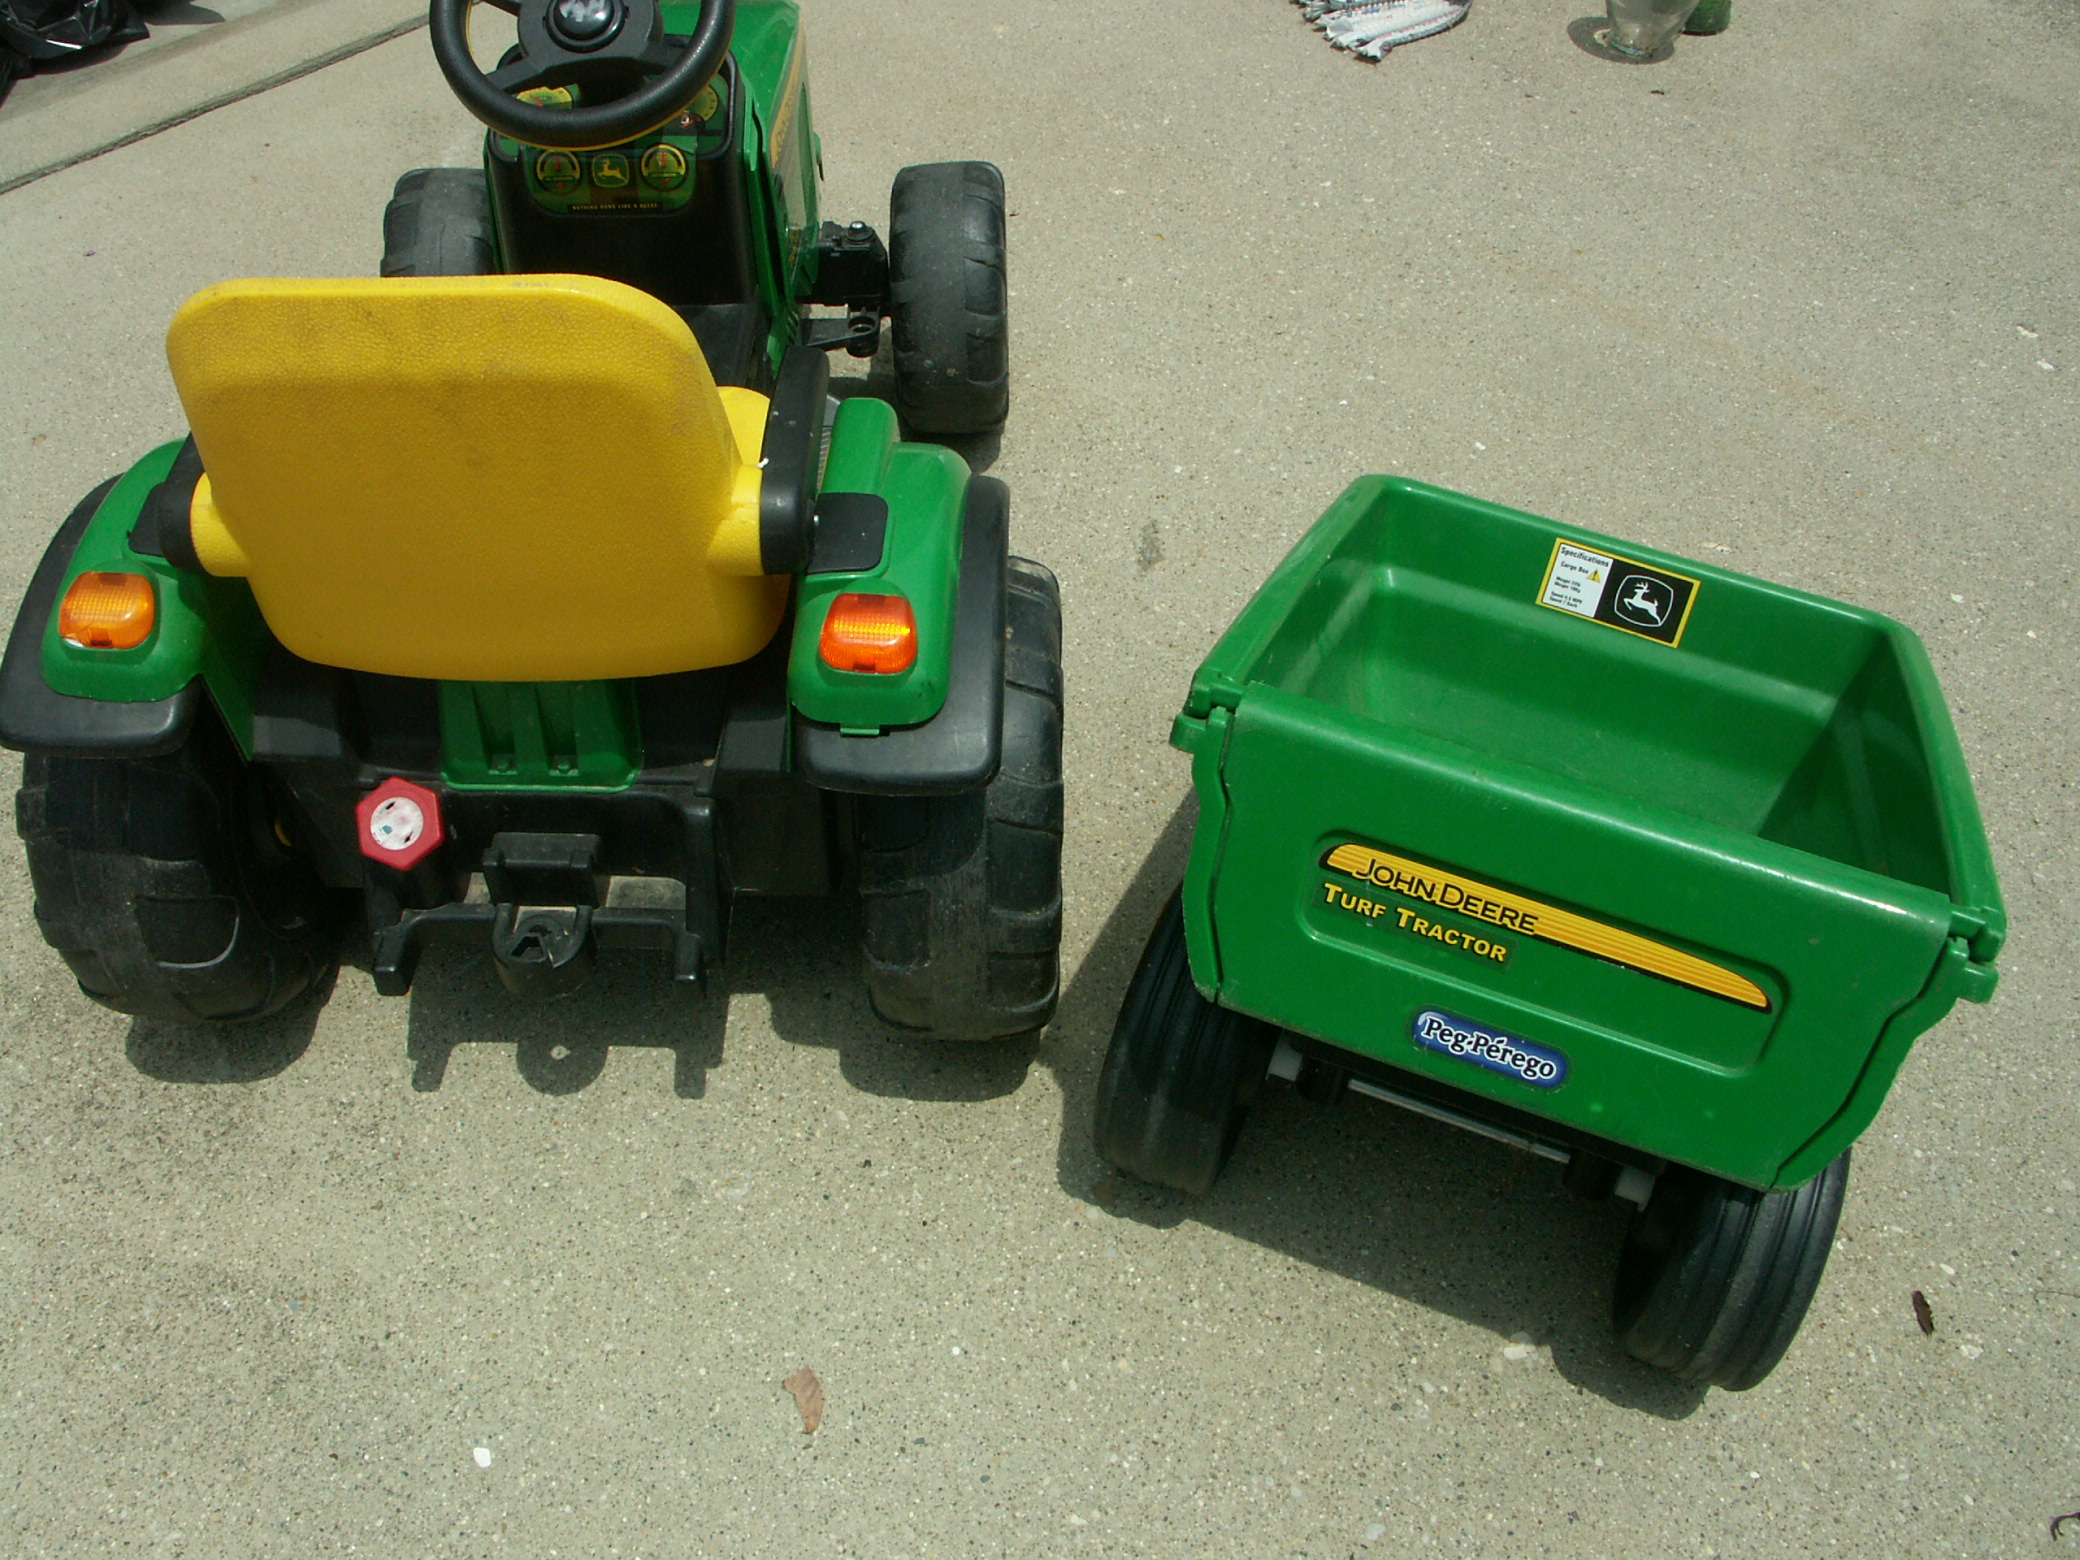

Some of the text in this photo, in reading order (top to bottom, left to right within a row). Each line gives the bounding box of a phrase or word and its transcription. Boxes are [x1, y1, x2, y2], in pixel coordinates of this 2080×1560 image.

[1561, 546, 1609, 567] Specifications
[1561, 560, 1589, 574] Cargo Box
[1355, 858, 1539, 933] JOHN DEERE
[1324, 882, 1507, 962] TURF TRACTOR
